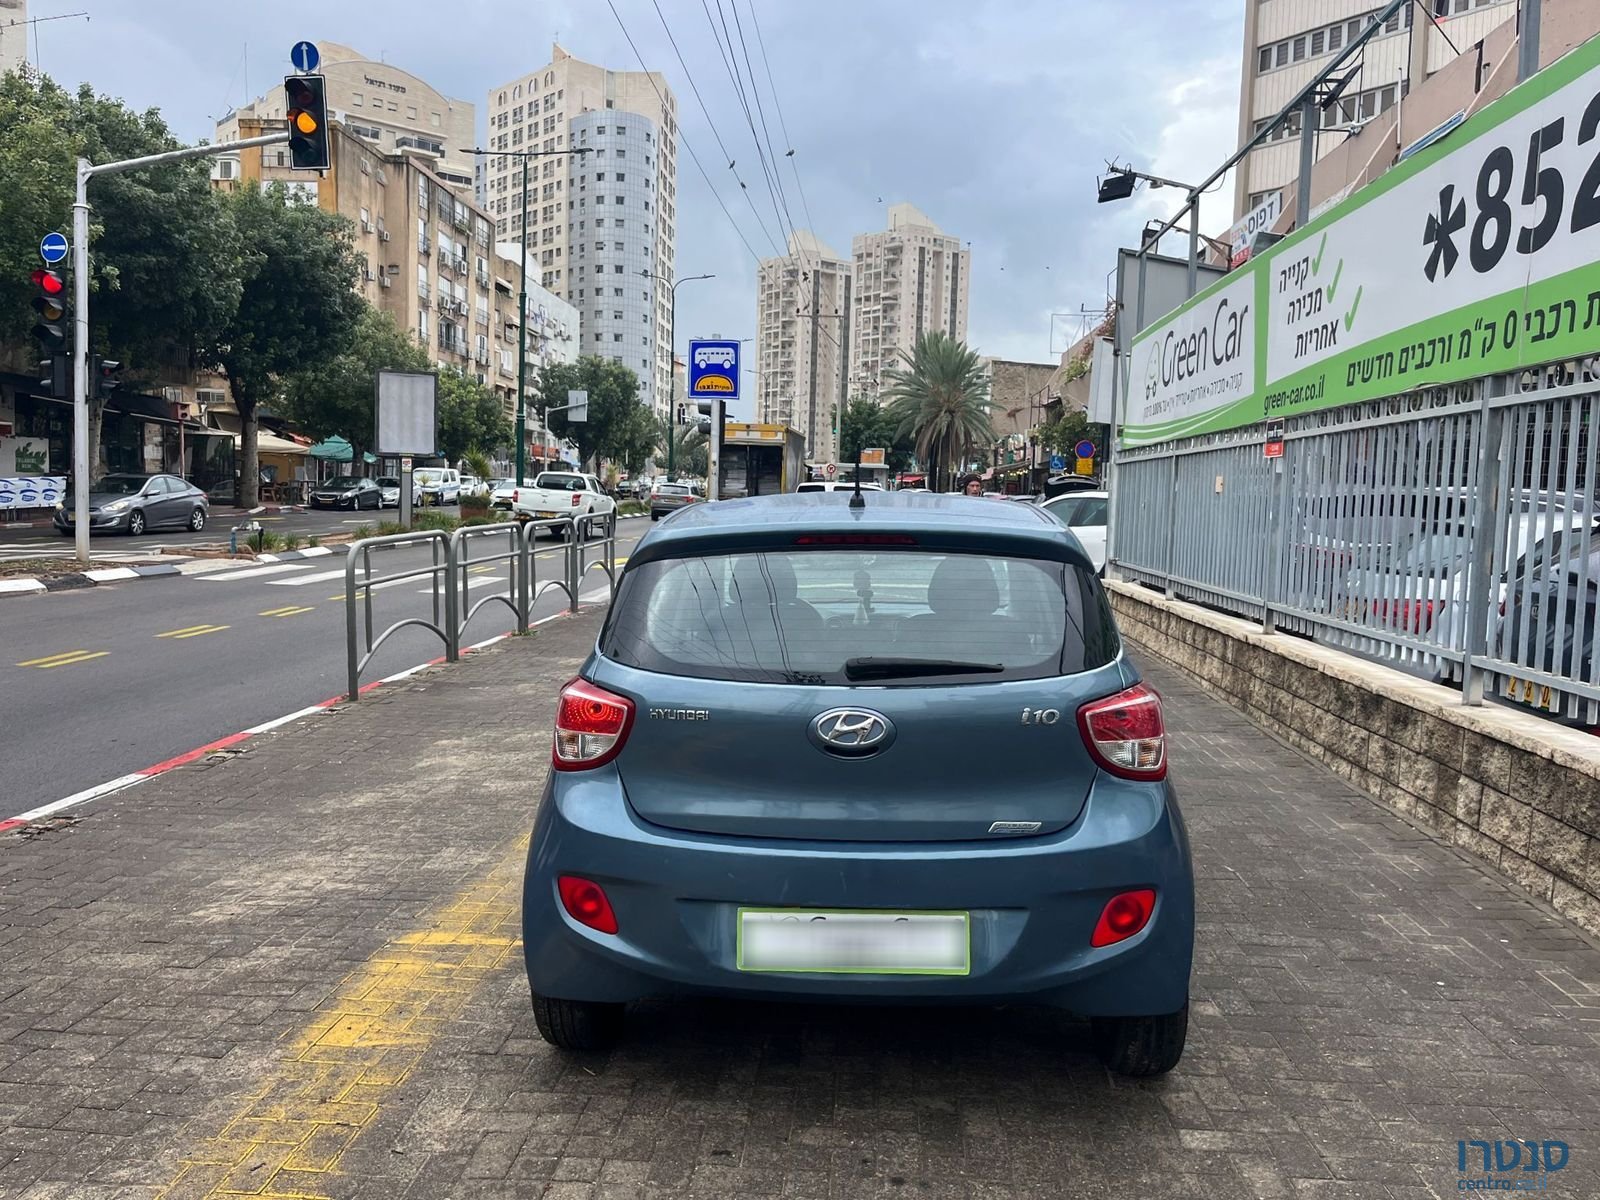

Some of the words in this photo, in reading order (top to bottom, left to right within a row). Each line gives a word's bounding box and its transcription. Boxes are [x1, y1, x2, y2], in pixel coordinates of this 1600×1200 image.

[1248, 201, 1275, 235] דפוס
[1279, 256, 1310, 294] קנייה
[1287, 287, 1323, 325] מכירה
[1524, 299, 1577, 343] רכבי
[1162, 327, 1207, 387] Green
[1212, 298, 1249, 366] Car
[1294, 319, 1340, 359] אחריות
[1503, 309, 1518, 350] 0
[1346, 351, 1394, 387] חדשים
[1398, 333, 1453, 375] ורכבים
[1263, 374, 1325, 416] green-car.co.il
[649, 708, 709, 720] HYUNDAI
[1021, 707, 1060, 725] i10
